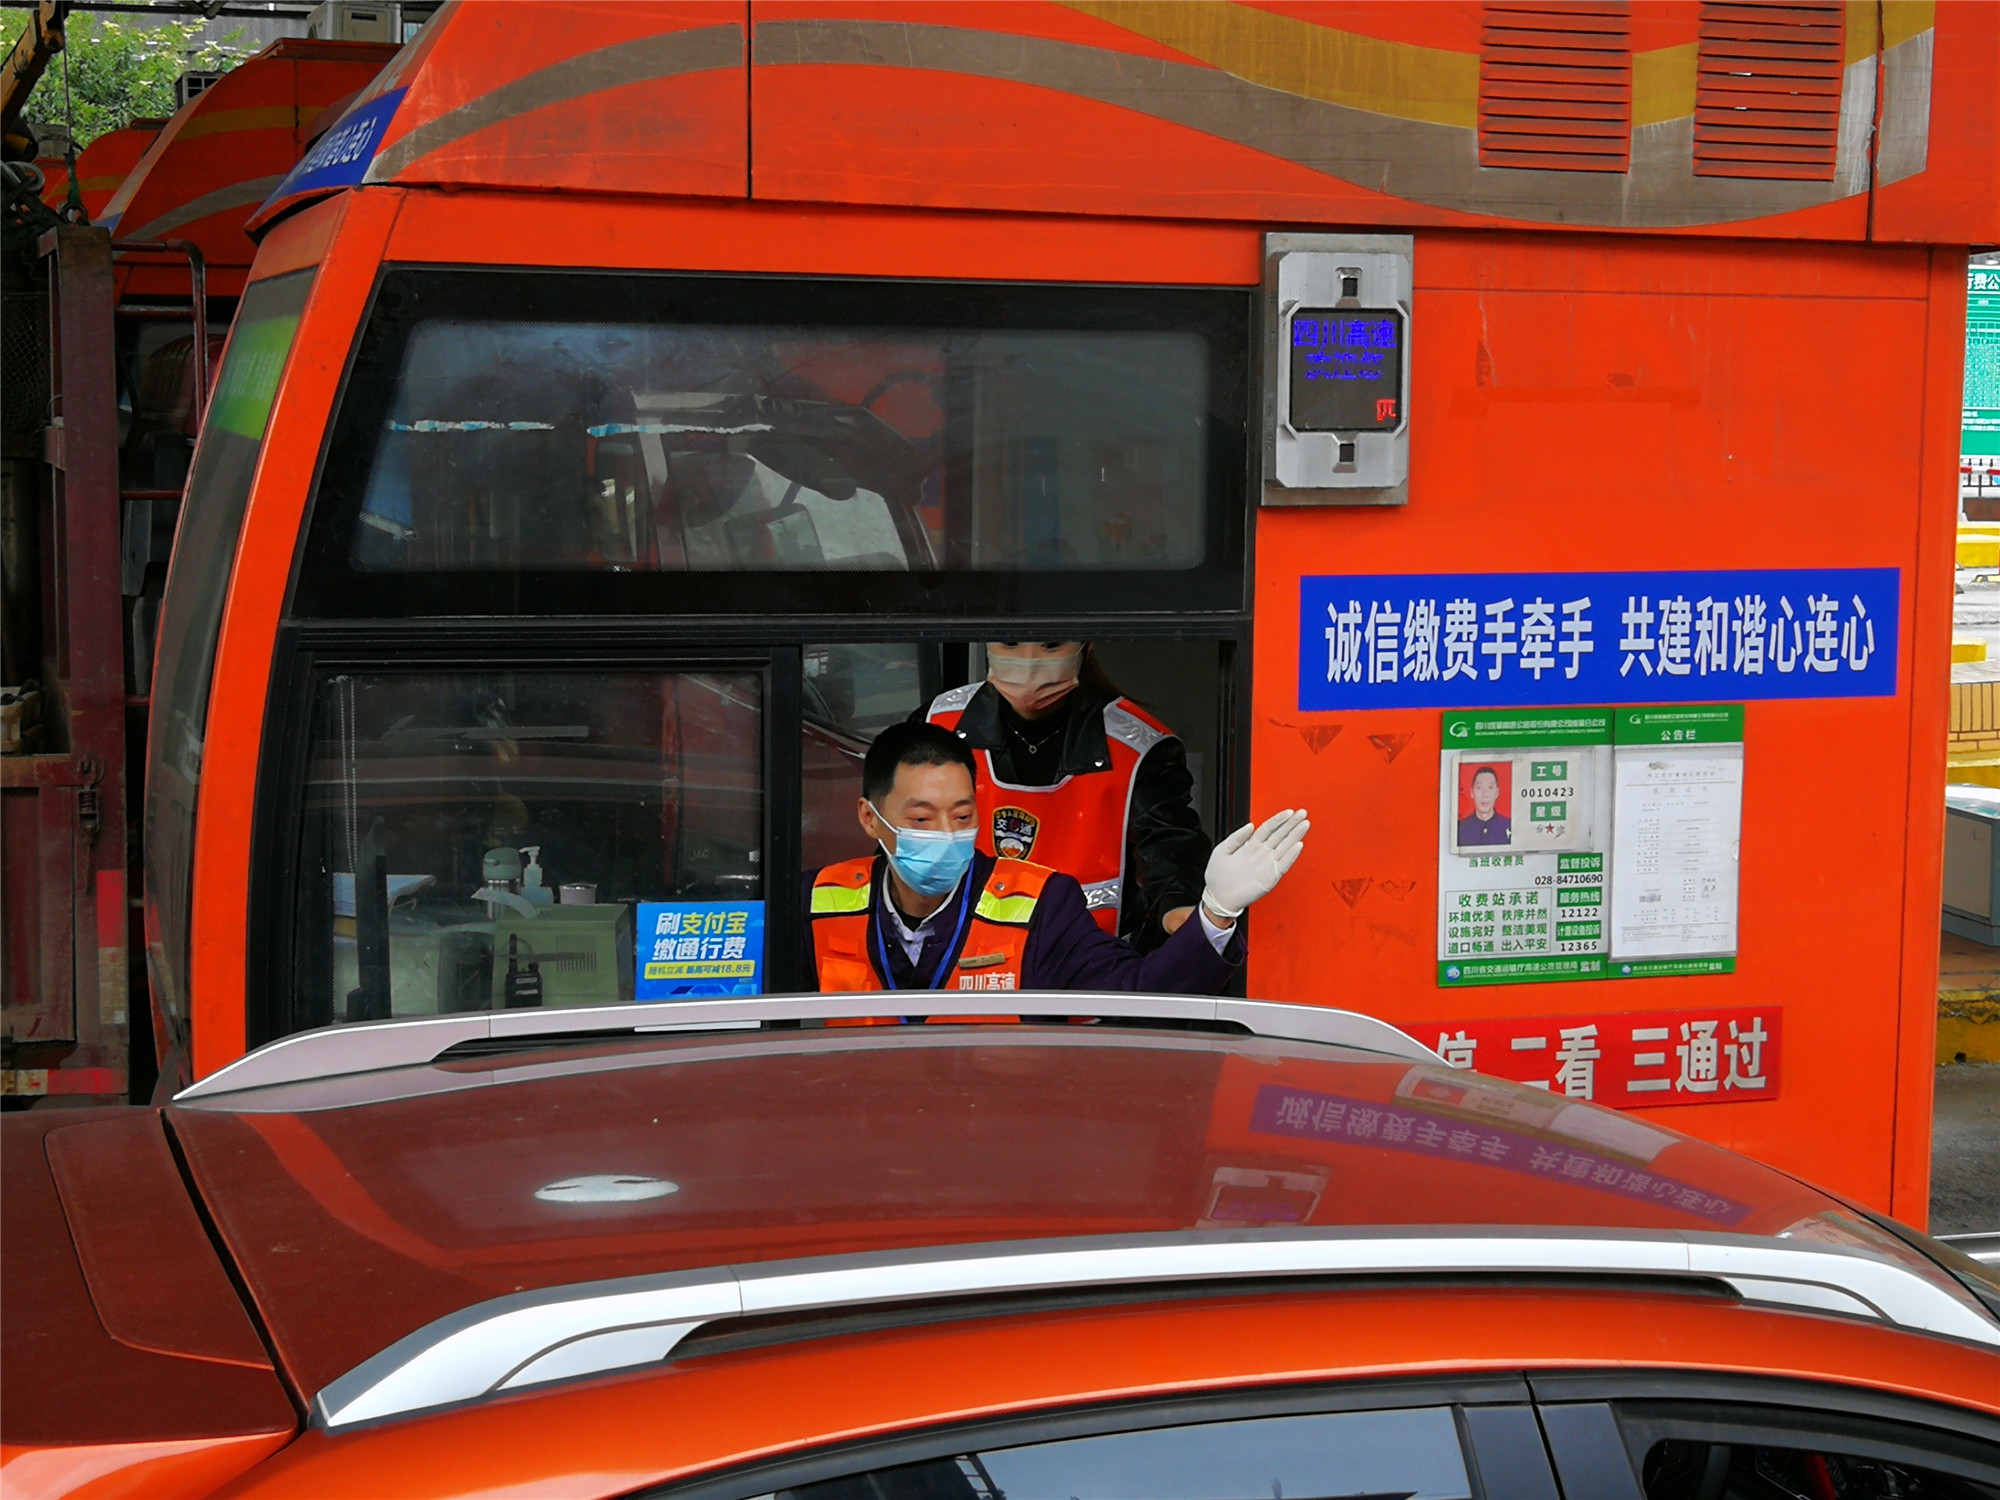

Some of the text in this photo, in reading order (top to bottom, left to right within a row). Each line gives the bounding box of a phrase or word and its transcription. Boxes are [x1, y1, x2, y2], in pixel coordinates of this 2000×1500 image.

[1294, 319, 1397, 349] 四川高速
[1325, 593, 1875, 684] 诚信缴费手牵手 共建和谐心连心
[1661, 729, 1696, 741] 公告栏
[1536, 765, 1562, 777] 工号
[1521, 787, 1574, 798] 0010423
[1536, 806, 1561, 817] 星级
[1469, 855, 1524, 868] 当班收费员
[1560, 857, 1601, 869] 监督投诉
[1535, 874, 1603, 885] 028-84710690
[1459, 891, 1538, 907] 收费站承诺
[1559, 891, 1600, 903] 服务热线
[1449, 908, 1548, 923] 环境优美 秩序井然
[1561, 908, 1598, 918] 12122
[656, 911, 748, 935] 刷支付宝
[1448, 923, 1547, 938] 设施完好 整洁美观
[652, 937, 746, 960] 缴通行费
[1448, 938, 1547, 954] 道口畅通 出入平安
[1560, 941, 1597, 952] 12365
[959, 972, 1016, 990] 四川高速
[1510, 1024, 1601, 1101] 二看
[1627, 1017, 1768, 1094] 三通过
